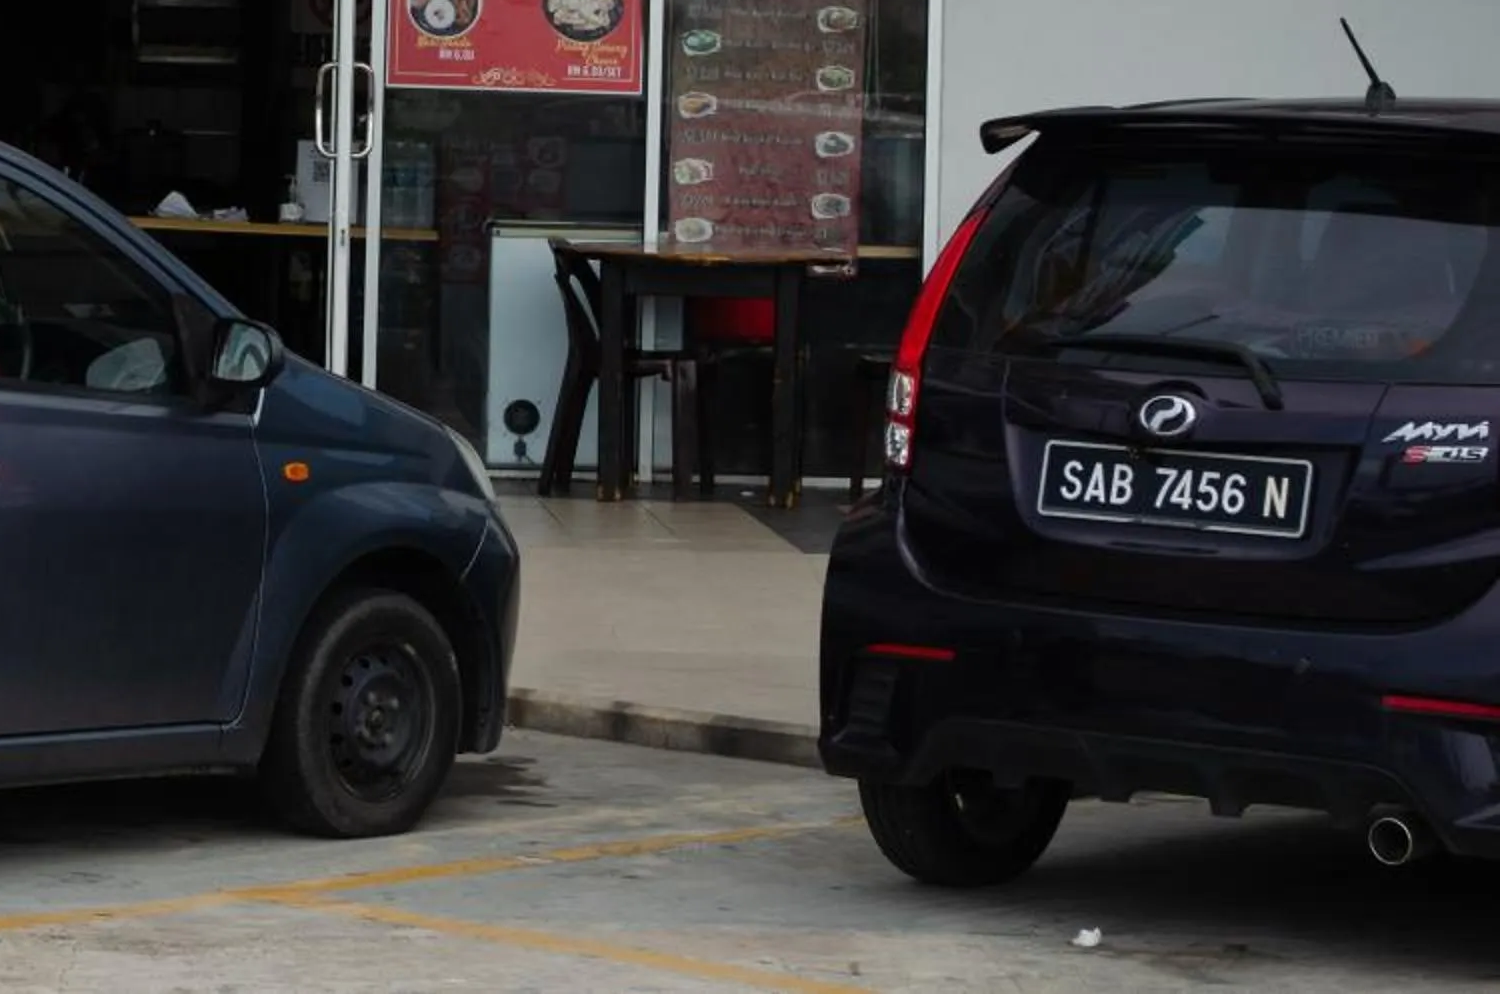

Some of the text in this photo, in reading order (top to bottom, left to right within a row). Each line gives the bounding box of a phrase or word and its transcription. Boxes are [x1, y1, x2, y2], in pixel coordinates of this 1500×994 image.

[1058, 459, 1290, 519] SAB 7456 N
